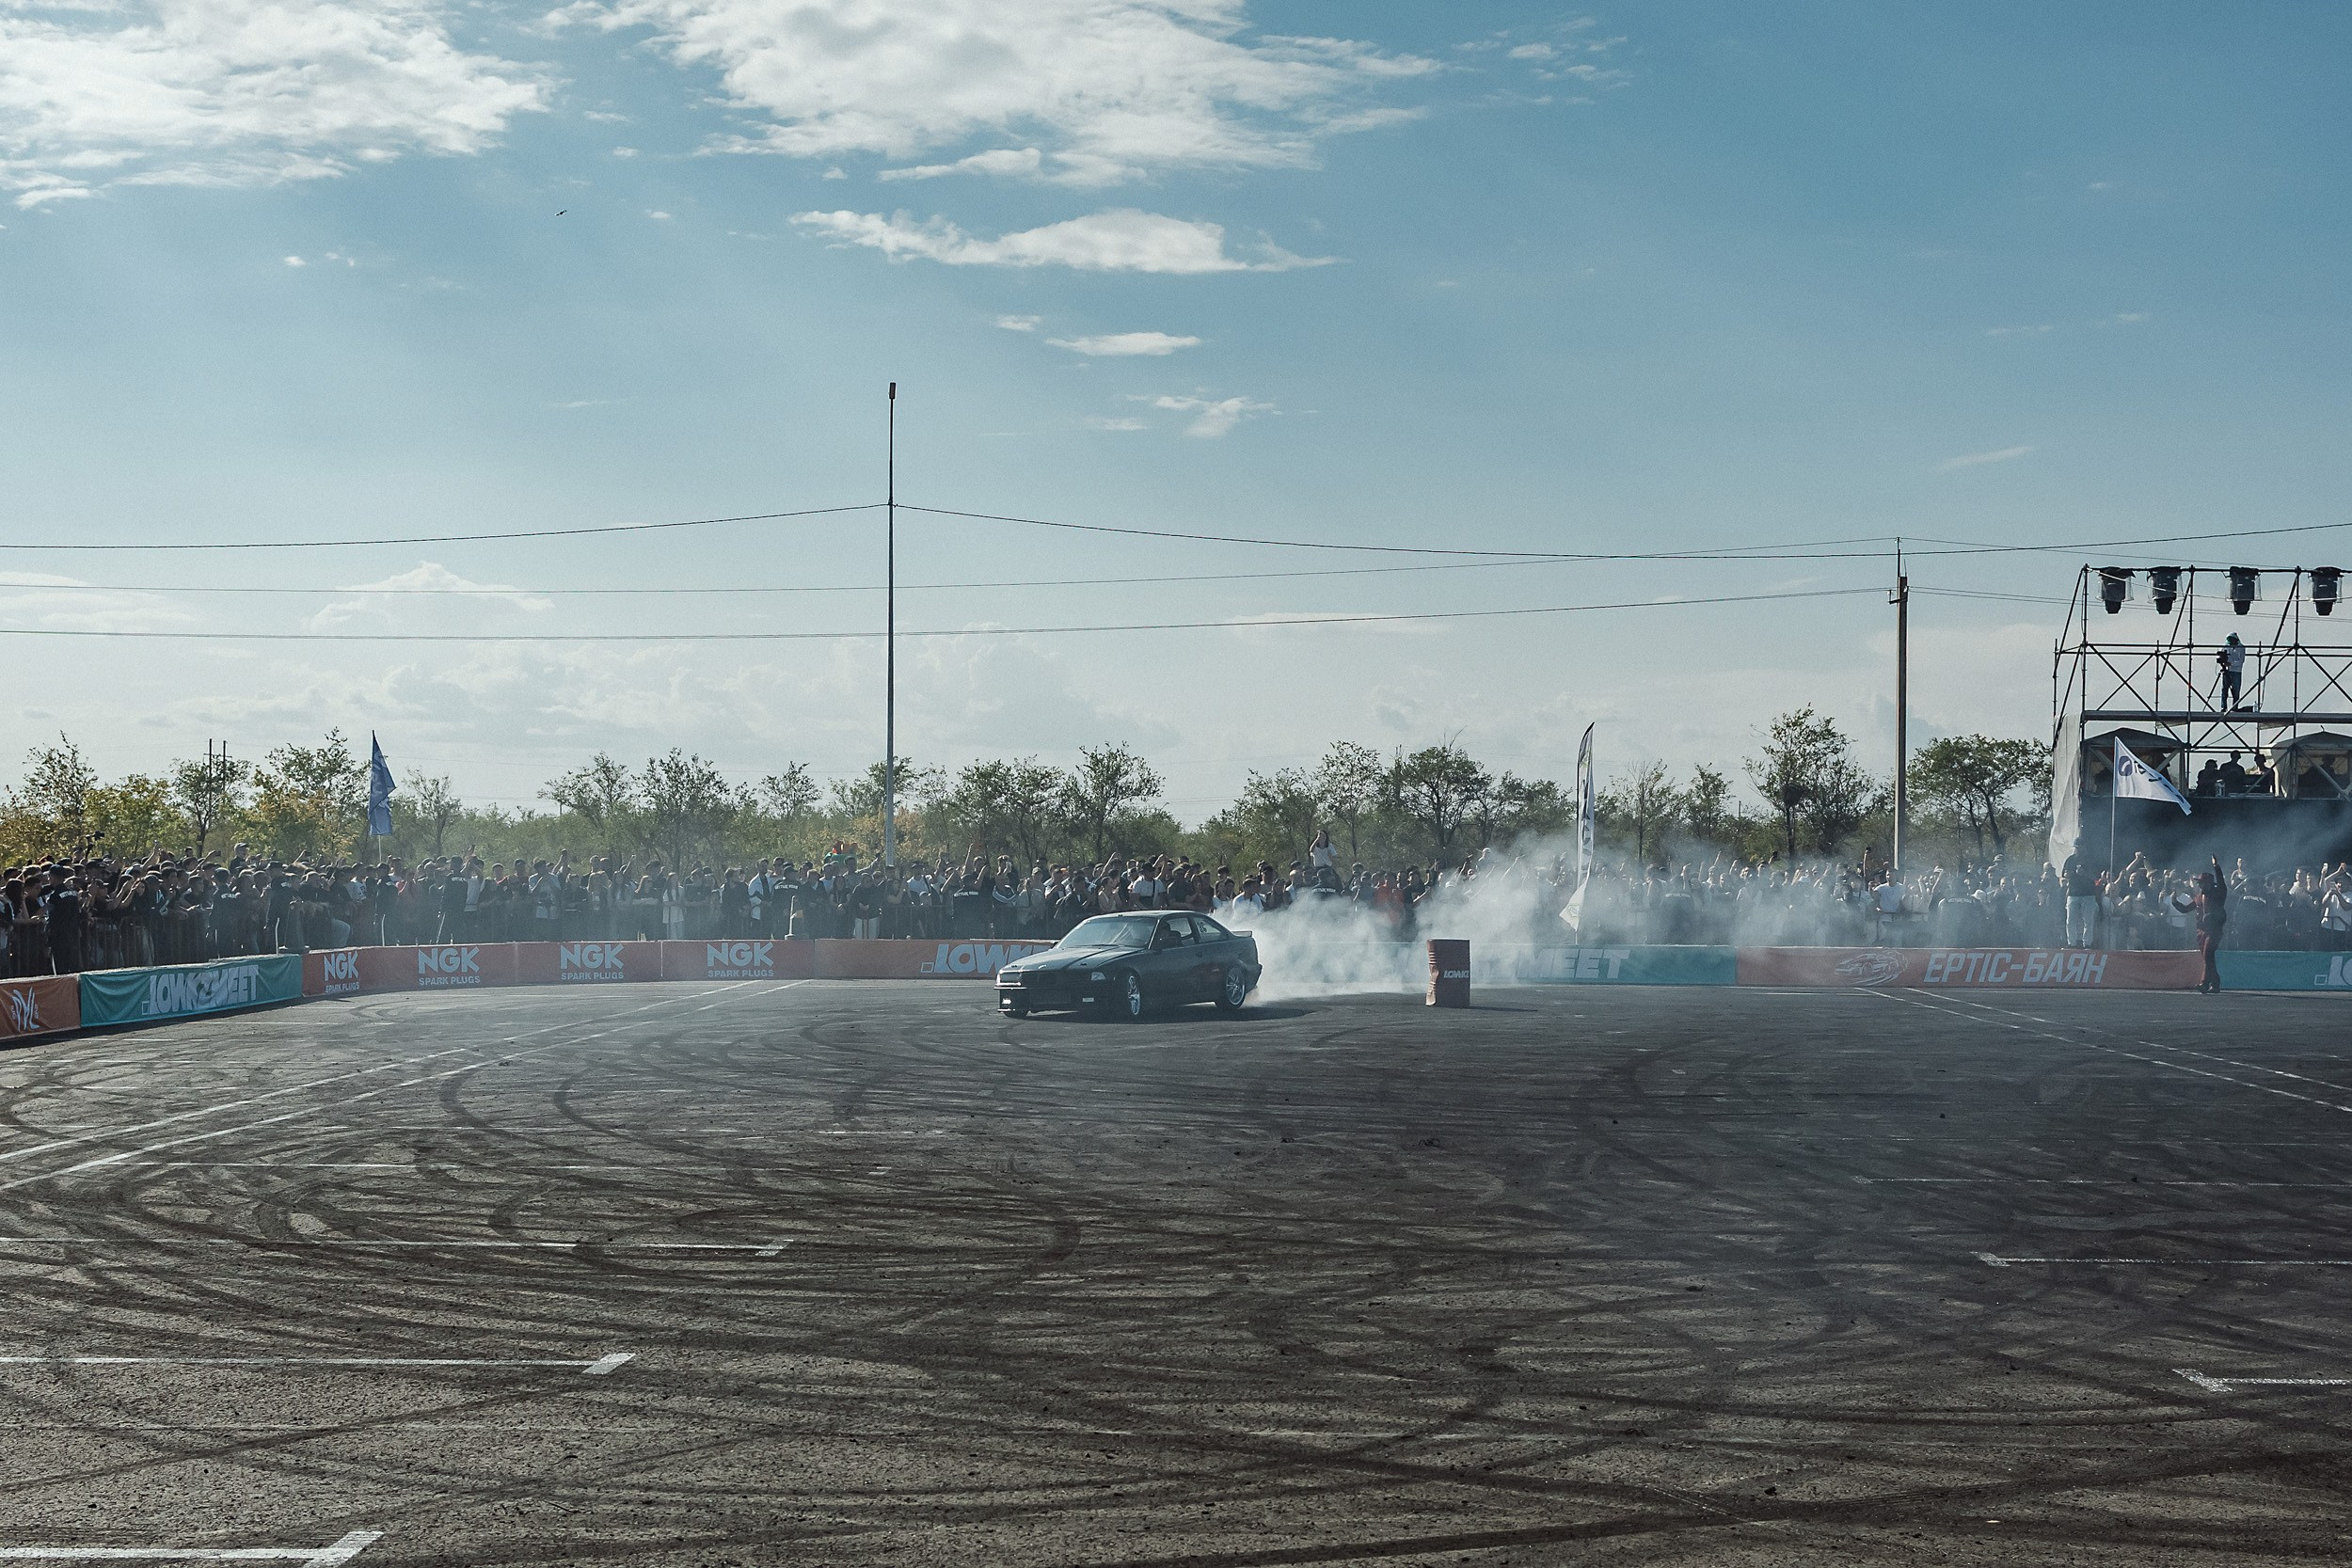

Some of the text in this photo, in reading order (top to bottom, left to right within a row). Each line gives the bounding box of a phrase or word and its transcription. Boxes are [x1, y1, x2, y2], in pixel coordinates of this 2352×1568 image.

[418, 946, 481, 974] NGK
[560, 942, 625, 970] NGK
[707, 942, 774, 967] NGK
[323, 950, 359, 982] NGK
[707, 969, 775, 978] SPARK PLUGS
[419, 975, 482, 987] SPARK PLUGS
[561, 972, 625, 981] SPARK PLUGS
[325, 981, 360, 993] SPARK PLUGS
